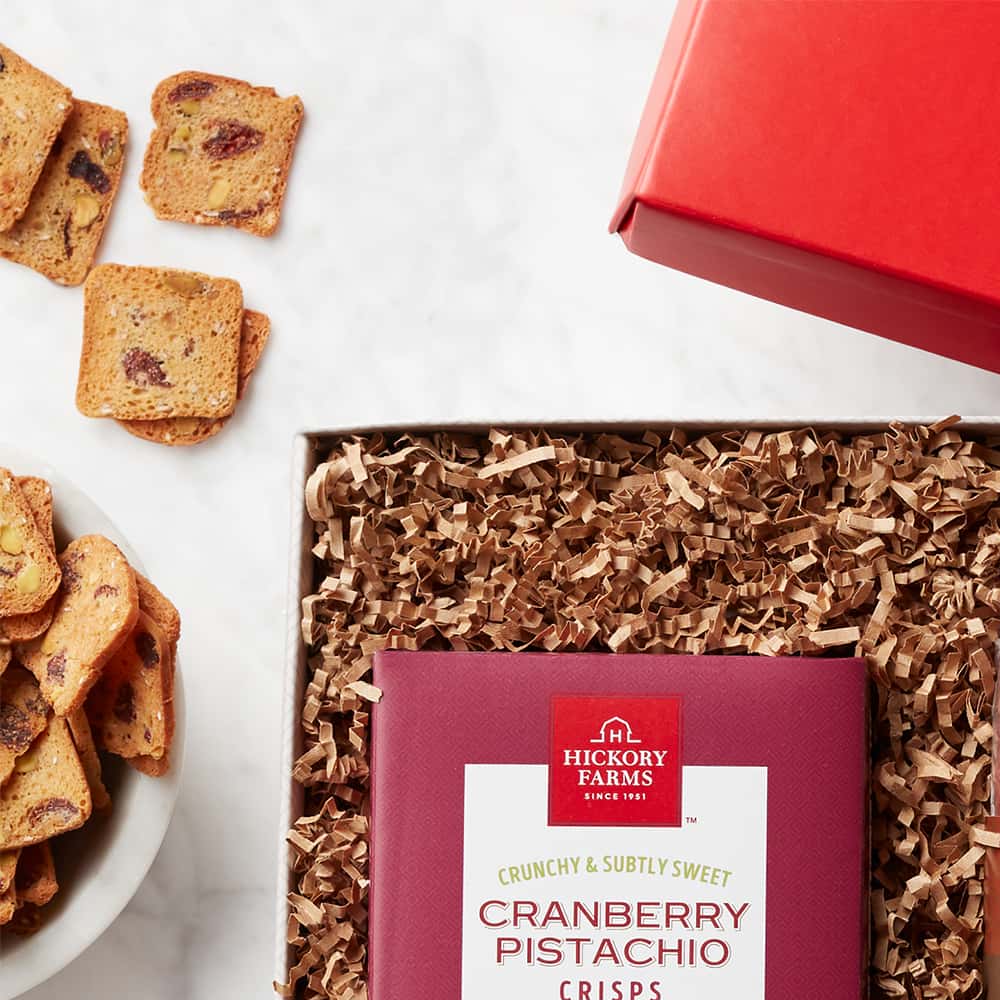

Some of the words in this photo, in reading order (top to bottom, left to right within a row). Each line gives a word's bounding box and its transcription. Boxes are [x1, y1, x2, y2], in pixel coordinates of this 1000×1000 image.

[609, 729, 622, 743] H
[563, 749, 668, 767] HICKORY
[577, 769, 653, 786] FARMS
[583, 792, 619, 801] SINCE
[623, 792, 647, 801] 1951
[685, 816, 698, 824] TM
[497, 856, 581, 886] CRUNCHY
[585, 857, 599, 873] &
[602, 855, 669, 876] SUBTLY
[671, 860, 733, 888] SWEET
[478, 899, 751, 930] CRANBERRY
[495, 936, 731, 967] PISTACHIO
